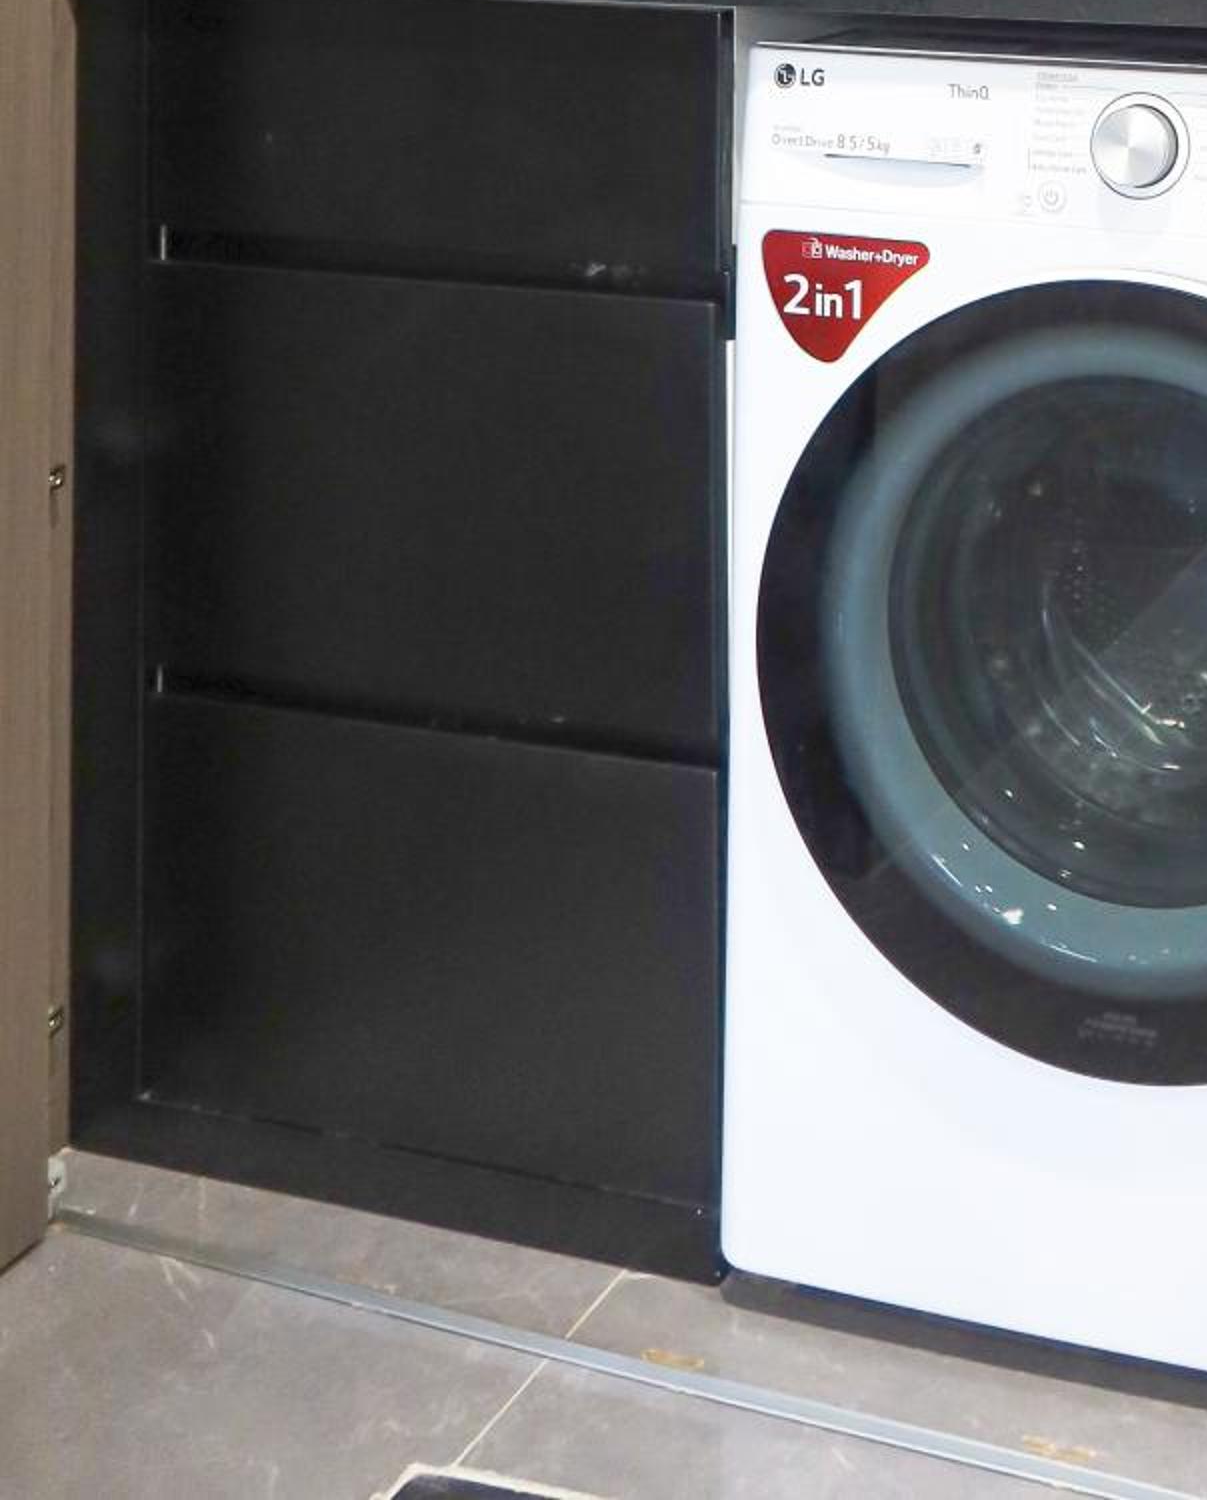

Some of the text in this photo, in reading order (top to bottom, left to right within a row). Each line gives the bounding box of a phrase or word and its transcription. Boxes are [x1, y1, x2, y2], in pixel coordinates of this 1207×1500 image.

[800, 68, 825, 86] LG
[948, 83, 990, 100] ThinQ
[825, 243, 919, 267] Washer+Dryer
